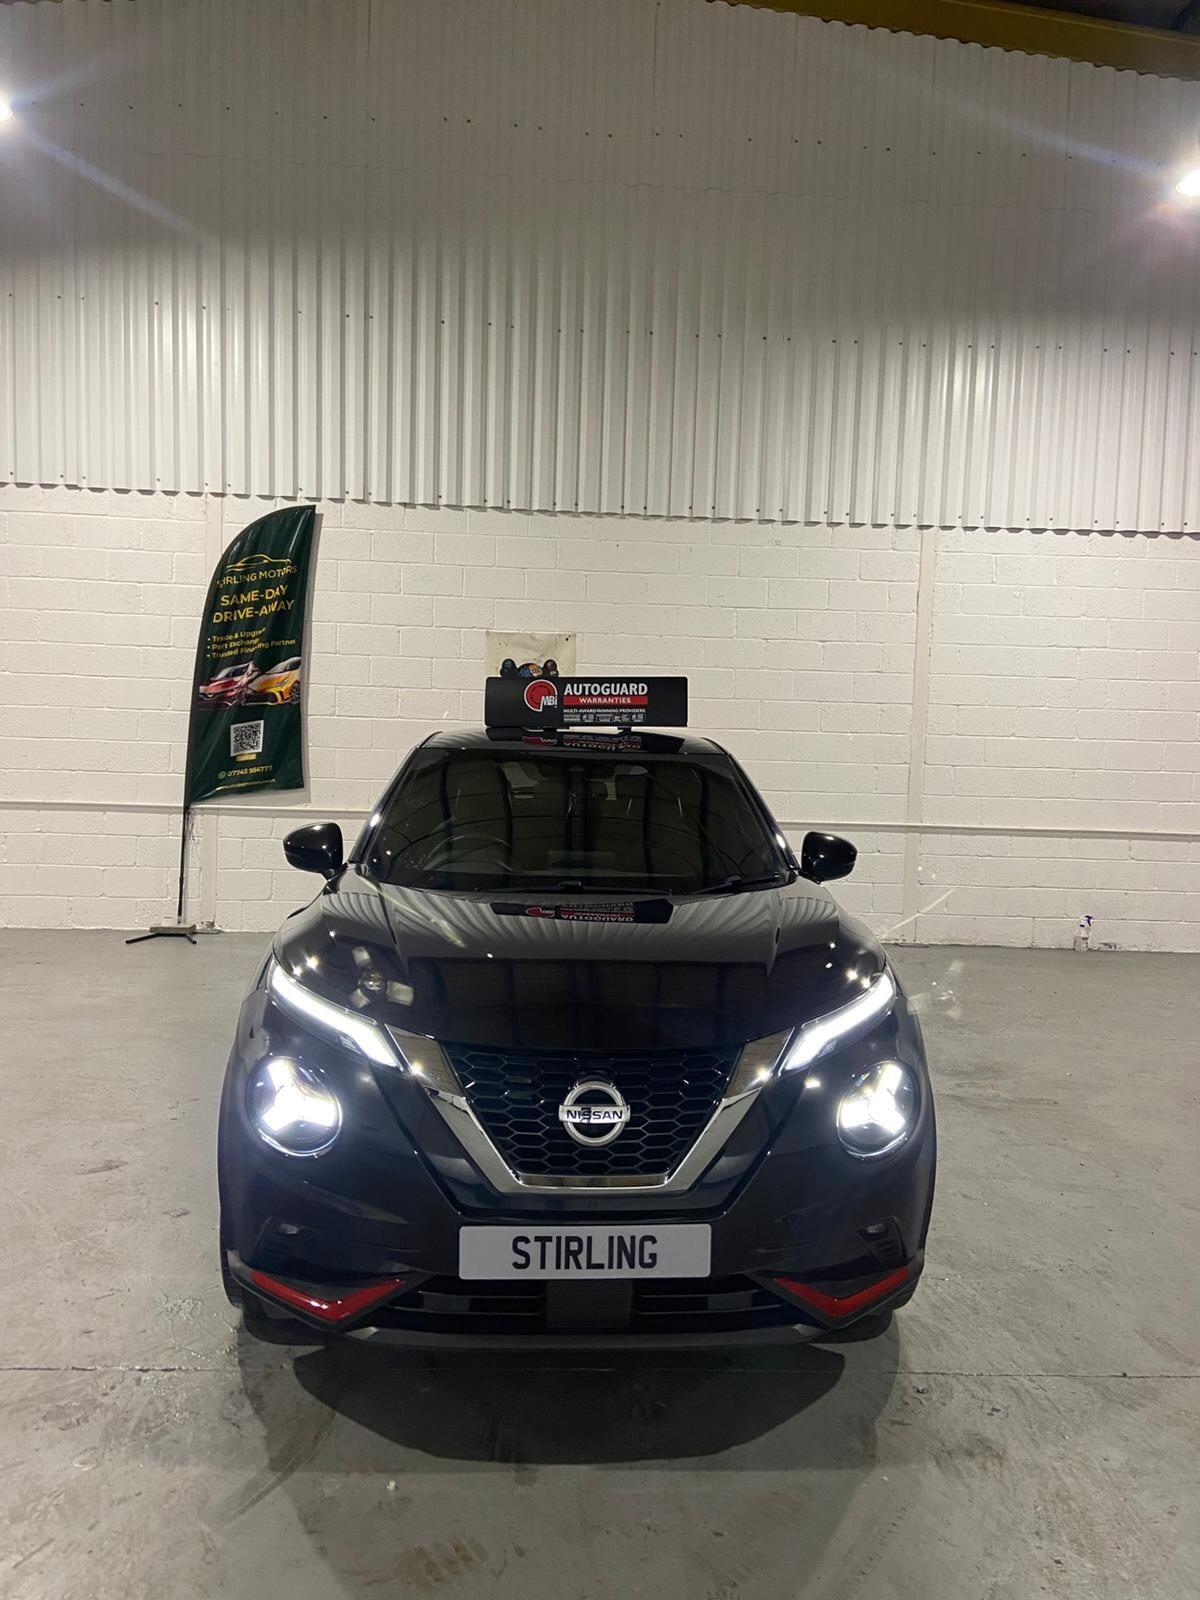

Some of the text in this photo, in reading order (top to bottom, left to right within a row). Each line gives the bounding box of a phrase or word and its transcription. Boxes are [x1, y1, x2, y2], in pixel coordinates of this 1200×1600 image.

[220, 584, 288, 606] SAME-DAY
[213, 600, 295, 623] DRIVE-AWAY
[212, 634, 233, 643] Trade
[212, 643, 228, 651] Part
[212, 638, 296, 659] Trusted Finaing Partner
[564, 683, 648, 696] AUTOGUARD
[566, 1109, 623, 1120] NISSAN
[512, 1235, 658, 1270] STIRLING
